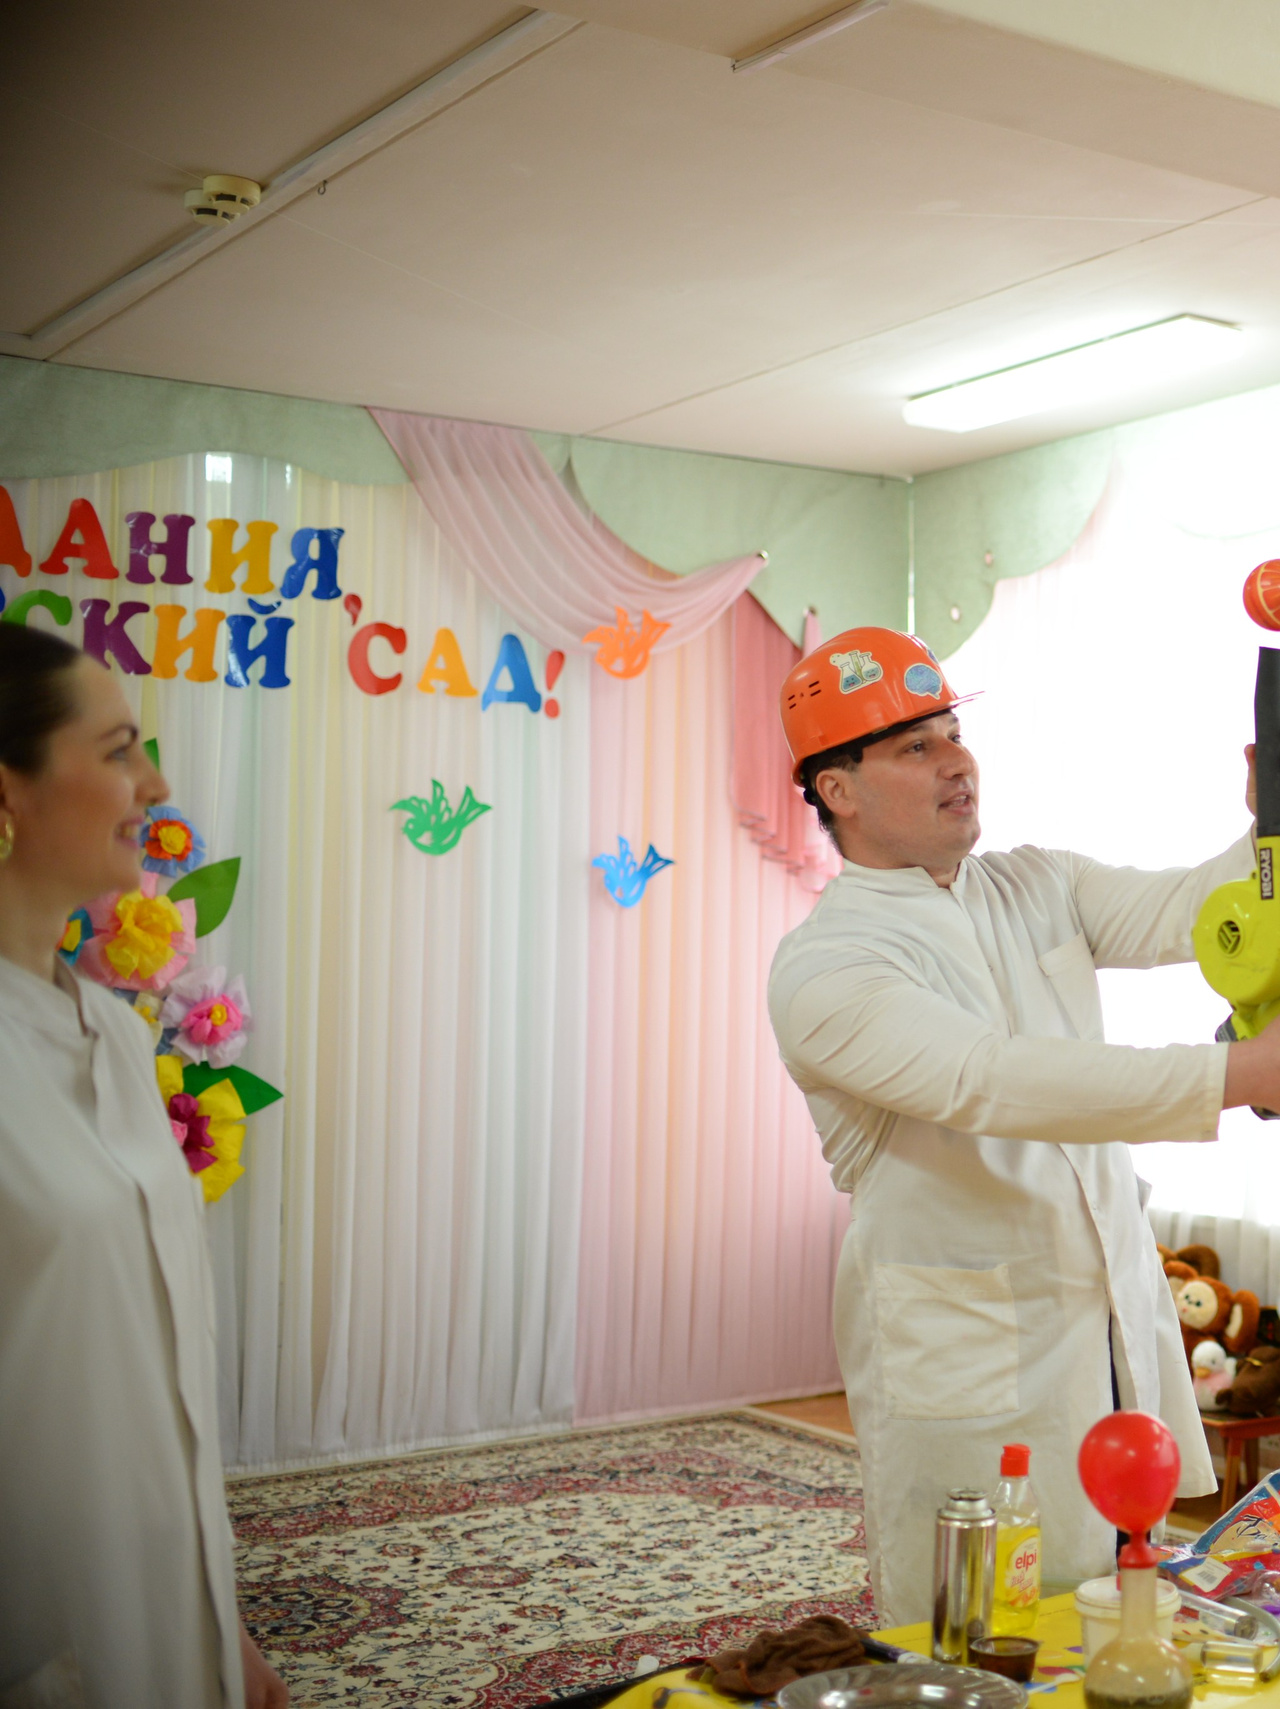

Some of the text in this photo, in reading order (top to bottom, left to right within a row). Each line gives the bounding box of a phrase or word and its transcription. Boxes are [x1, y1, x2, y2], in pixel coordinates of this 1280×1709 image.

[348, 622, 565, 718] САД!
[1260, 849, 1272, 897] RYOBI
[1015, 1548, 1037, 1571] elpi
